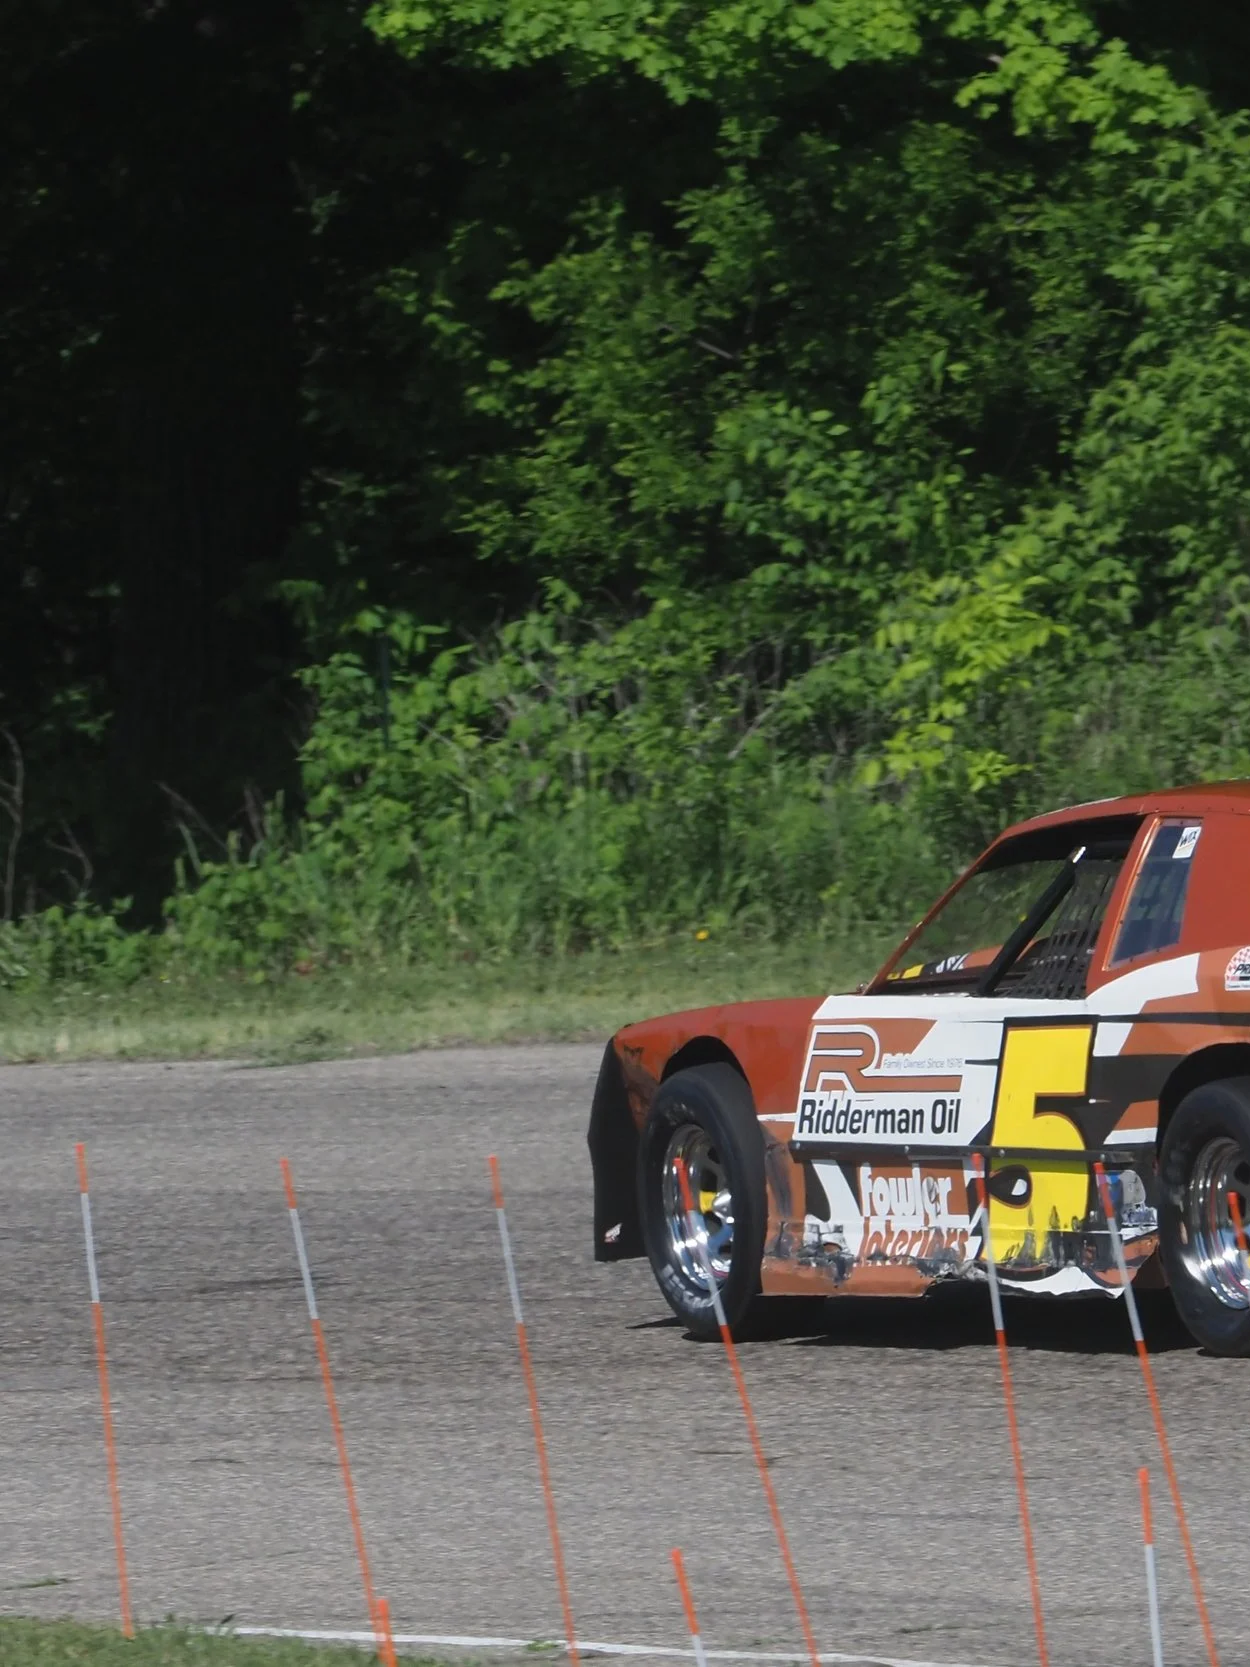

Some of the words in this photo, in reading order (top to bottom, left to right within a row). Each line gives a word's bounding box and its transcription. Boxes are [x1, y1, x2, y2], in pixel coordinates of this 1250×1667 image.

[927, 1057, 945, 1069] Since
[798, 1099, 925, 1134] Ridderman
[931, 1098, 962, 1134] Oil
[981, 1024, 1094, 1264] 5
